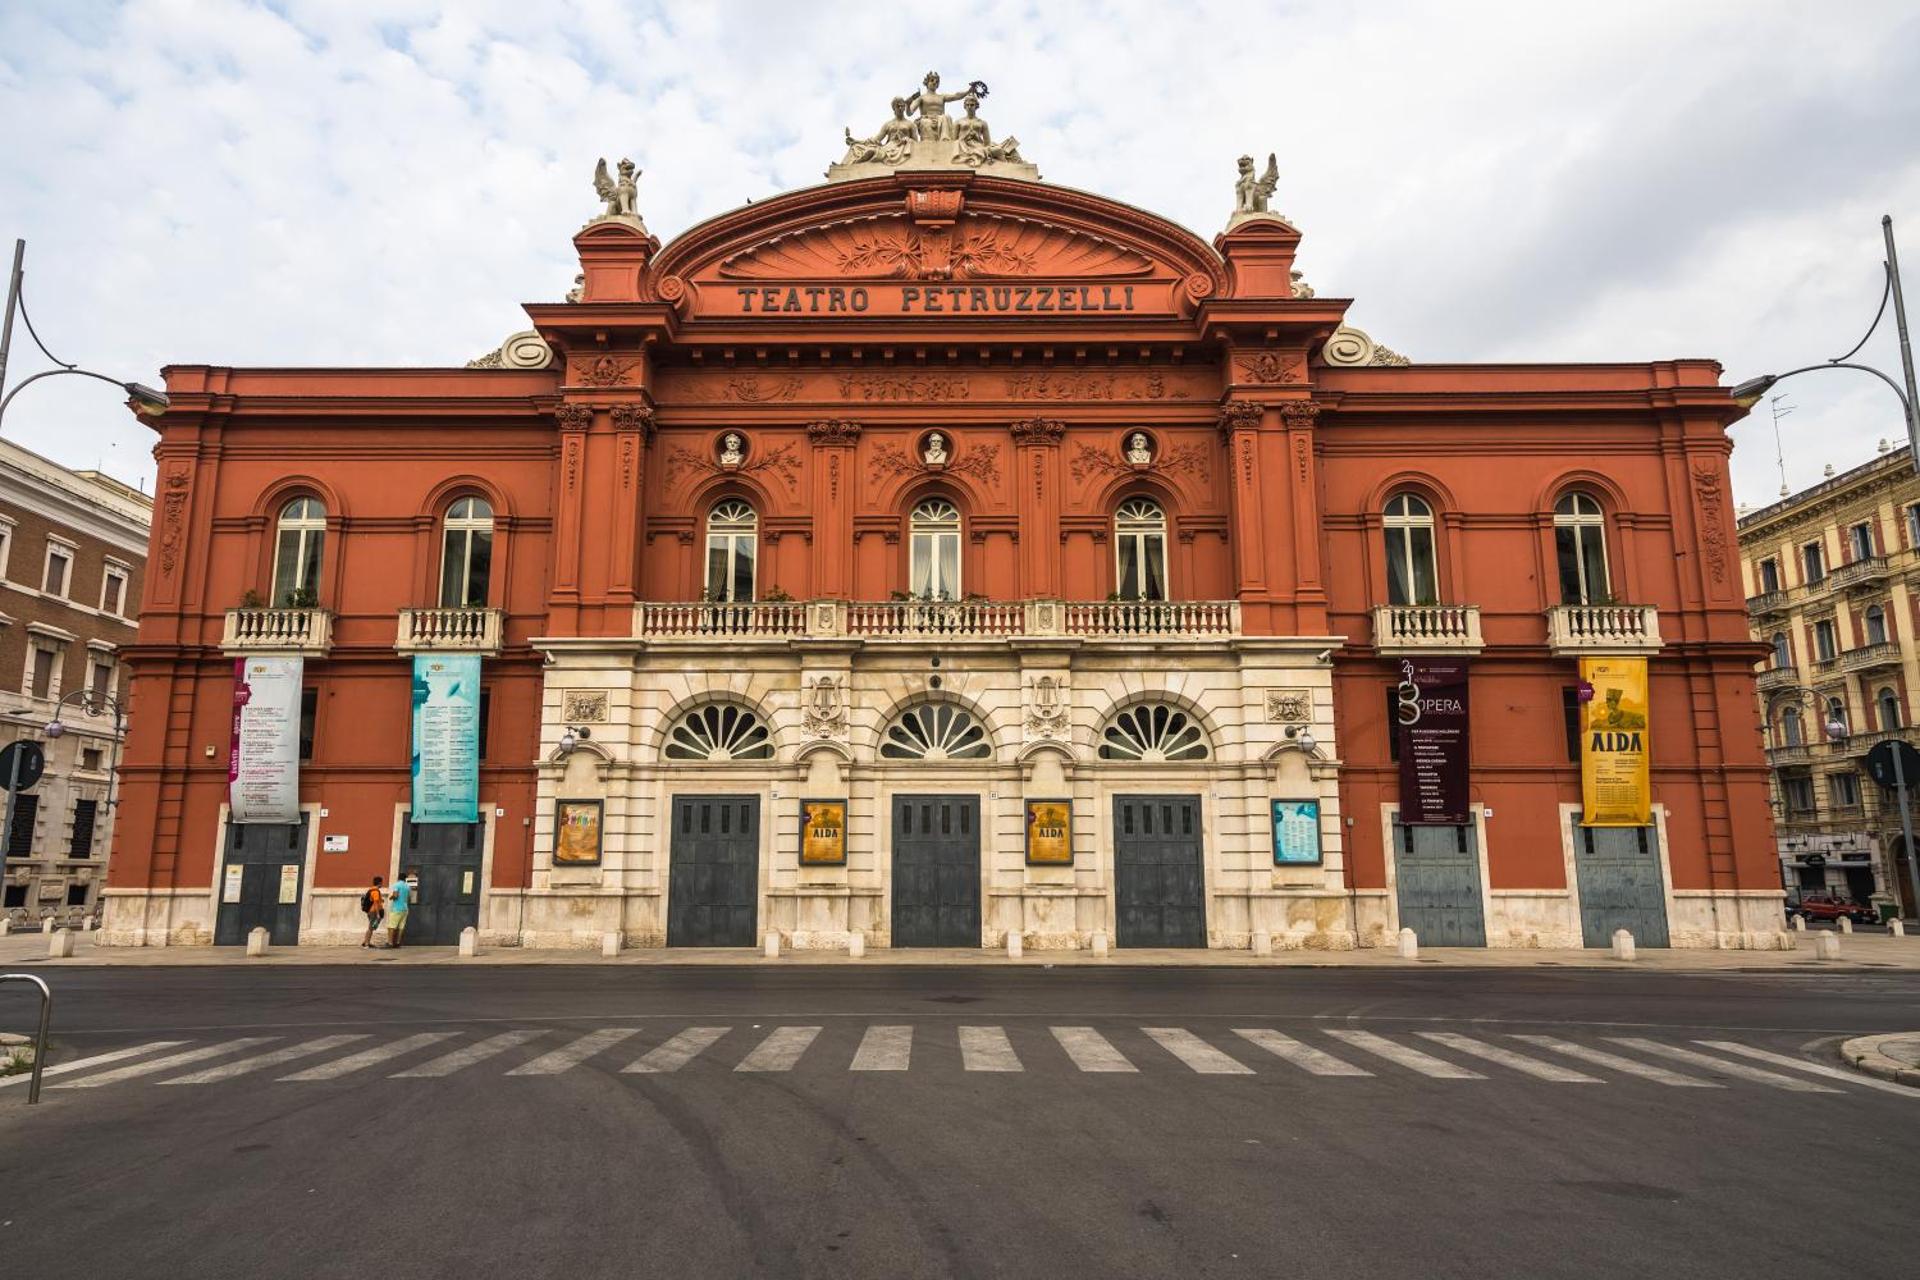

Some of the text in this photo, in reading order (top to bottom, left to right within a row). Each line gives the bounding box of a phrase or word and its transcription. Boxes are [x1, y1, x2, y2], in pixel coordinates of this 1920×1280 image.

[737, 286, 1135, 312] TEATRO PETRUZZELLI
[1418, 699, 1462, 712] OPERA
[1591, 732, 1642, 752] AIDA
[813, 828, 838, 838] AIDA
[1039, 828, 1064, 838] AIDA
